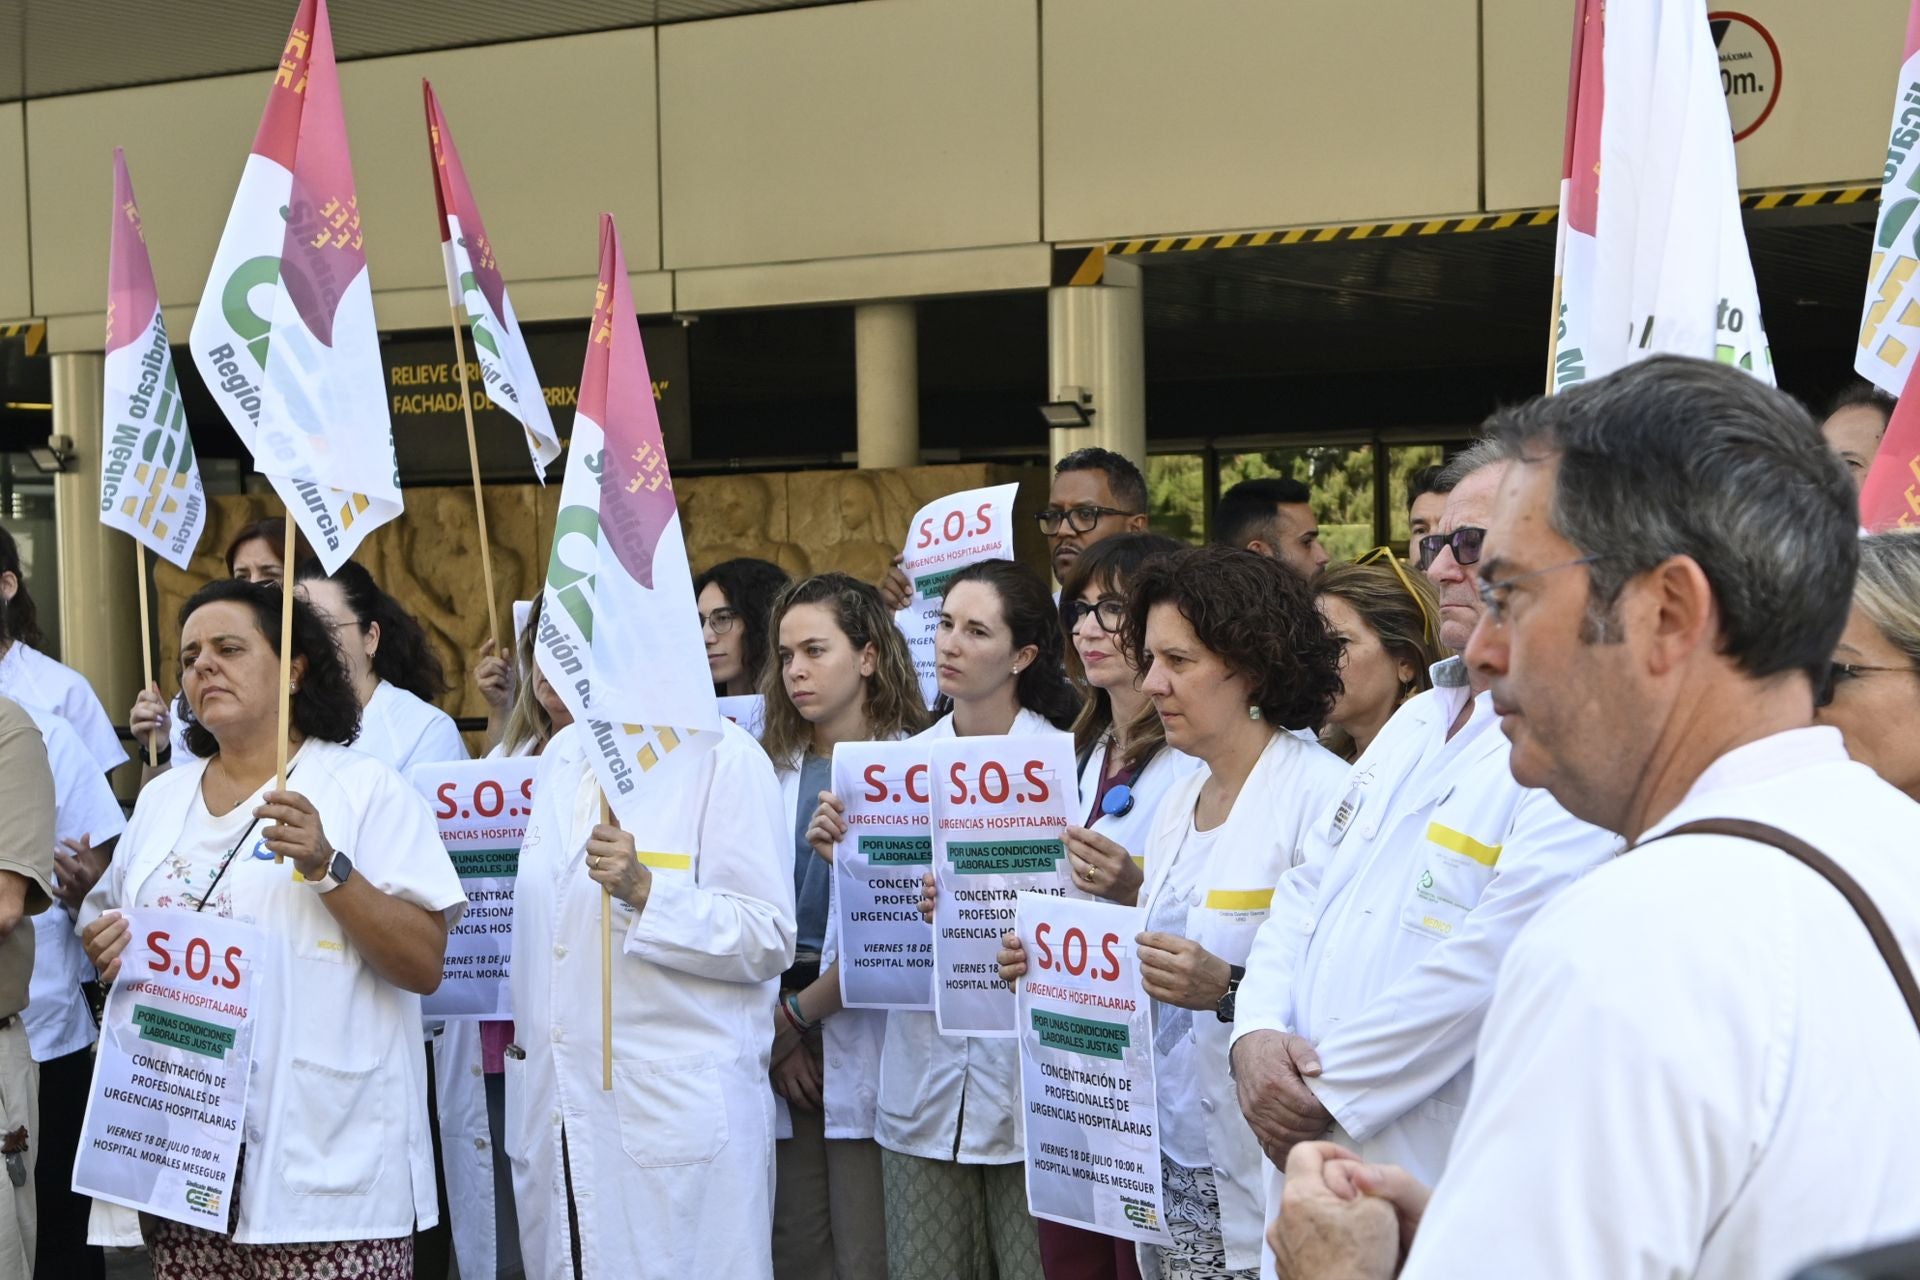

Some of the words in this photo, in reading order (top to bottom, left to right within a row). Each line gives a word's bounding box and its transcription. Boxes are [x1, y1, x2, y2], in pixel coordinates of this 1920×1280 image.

[1719, 51, 1753, 62] MÁXIMA
[392, 364, 448, 385] RELIEVE
[393, 393, 465, 414] FACHADA
[542, 386, 577, 406] RRIX
[917, 503, 993, 549] S.O.S
[905, 552, 945, 570] URGENCIAS
[946, 541, 1002, 561] HOSPITALARIAS
[917, 579, 932, 588] POR
[587, 718, 635, 796] Murcia
[950, 760, 1049, 805] S.O.S
[437, 778, 533, 819] S.O.S
[482, 828, 526, 839] HOSPITA
[849, 815, 908, 825] URGENCIAS
[939, 818, 984, 829] URGENCIAS
[987, 816, 1067, 828] HOSPITALARIAS
[460, 854, 484, 863] UNAS
[863, 841, 883, 849] POR
[885, 841, 913, 849] UNAS
[873, 852, 933, 861] LABORALES
[949, 848, 965, 857] POR
[965, 847, 990, 856] UNAS
[991, 844, 1060, 856] CONDICIONES
[957, 860, 1009, 869] LABORALES
[1011, 858, 1051, 868] JUSTAS
[851, 912, 918, 921] URGENCIAS
[942, 928, 997, 939] URGENCIAS
[146, 931, 242, 989] S.O.S
[476, 955, 485, 964] 18
[488, 955, 500, 963] DE
[864, 944, 903, 952] VIERNES
[906, 944, 917, 952] 18
[920, 944, 932, 952] DE
[1035, 922, 1120, 981] S.O.S
[476, 970, 509, 978] MORAL
[854, 959, 904, 967] HOSPITAL
[953, 964, 986, 973] VIERNES
[989, 964, 999, 973] 18
[946, 980, 988, 990] HOSPITAL
[1025, 981, 1067, 1000] URGENCIAS
[1069, 990, 1136, 1012] HOSPITALARIAS
[127, 983, 180, 1001] URGENCIAS
[182, 993, 248, 1018] HOSPITALARIAS
[137, 1011, 156, 1024] POR
[157, 1016, 178, 1028] UNAS
[179, 1020, 232, 1043] CONDICIONES
[144, 1026, 190, 1045] LABORALES
[191, 1037, 222, 1054] JUSTAS
[1034, 1015, 1049, 1027] POR
[1050, 1019, 1069, 1032] UNAS
[1070, 1023, 1126, 1041] CONDICIONES
[1042, 1031, 1084, 1048] LABORALES
[1086, 1039, 1118, 1053] JUSTAS
[132, 1054, 212, 1084] CONCENTRACIÓN
[214, 1076, 226, 1088] DE
[1041, 1063, 1115, 1089] CONCENTRACIÓN
[1119, 1079, 1131, 1091] DE
[131, 1074, 206, 1103] PROFESIONALES
[208, 1094, 220, 1106] DE
[1045, 1085, 1114, 1110] PROFESIONALES
[1117, 1099, 1129, 1112] DE
[104, 1087, 162, 1110] URGENCIAS
[165, 1103, 236, 1131] HOSPITALARIAS
[1031, 1101, 1076, 1123] URGENCIAS
[1078, 1113, 1152, 1137] HOSPITALARIAS
[106, 1124, 142, 1141] VIERNES
[144, 1134, 154, 1144] 18
[155, 1137, 167, 1148] DE
[165, 1139, 189, 1154] JULIO
[191, 1147, 212, 1160] 10:00
[213, 1153, 220, 1163] H.
[93, 1138, 137, 1158] HOSPITAL
[140, 1150, 180, 1169] MORALES
[182, 1162, 226, 1182] MESEGUER
[1040, 1142, 1068, 1158] VIERNES
[1071, 1150, 1078, 1160] 18
[1081, 1151, 1089, 1163] DE
[1091, 1153, 1112, 1167] JULIO
[1115, 1159, 1135, 1172] 10:00
[1136, 1163, 1144, 1174] H.
[1035, 1158, 1071, 1177] HOSPITAL
[1072, 1167, 1109, 1184] MORALES
[1111, 1176, 1155, 1194] MESEGUER
